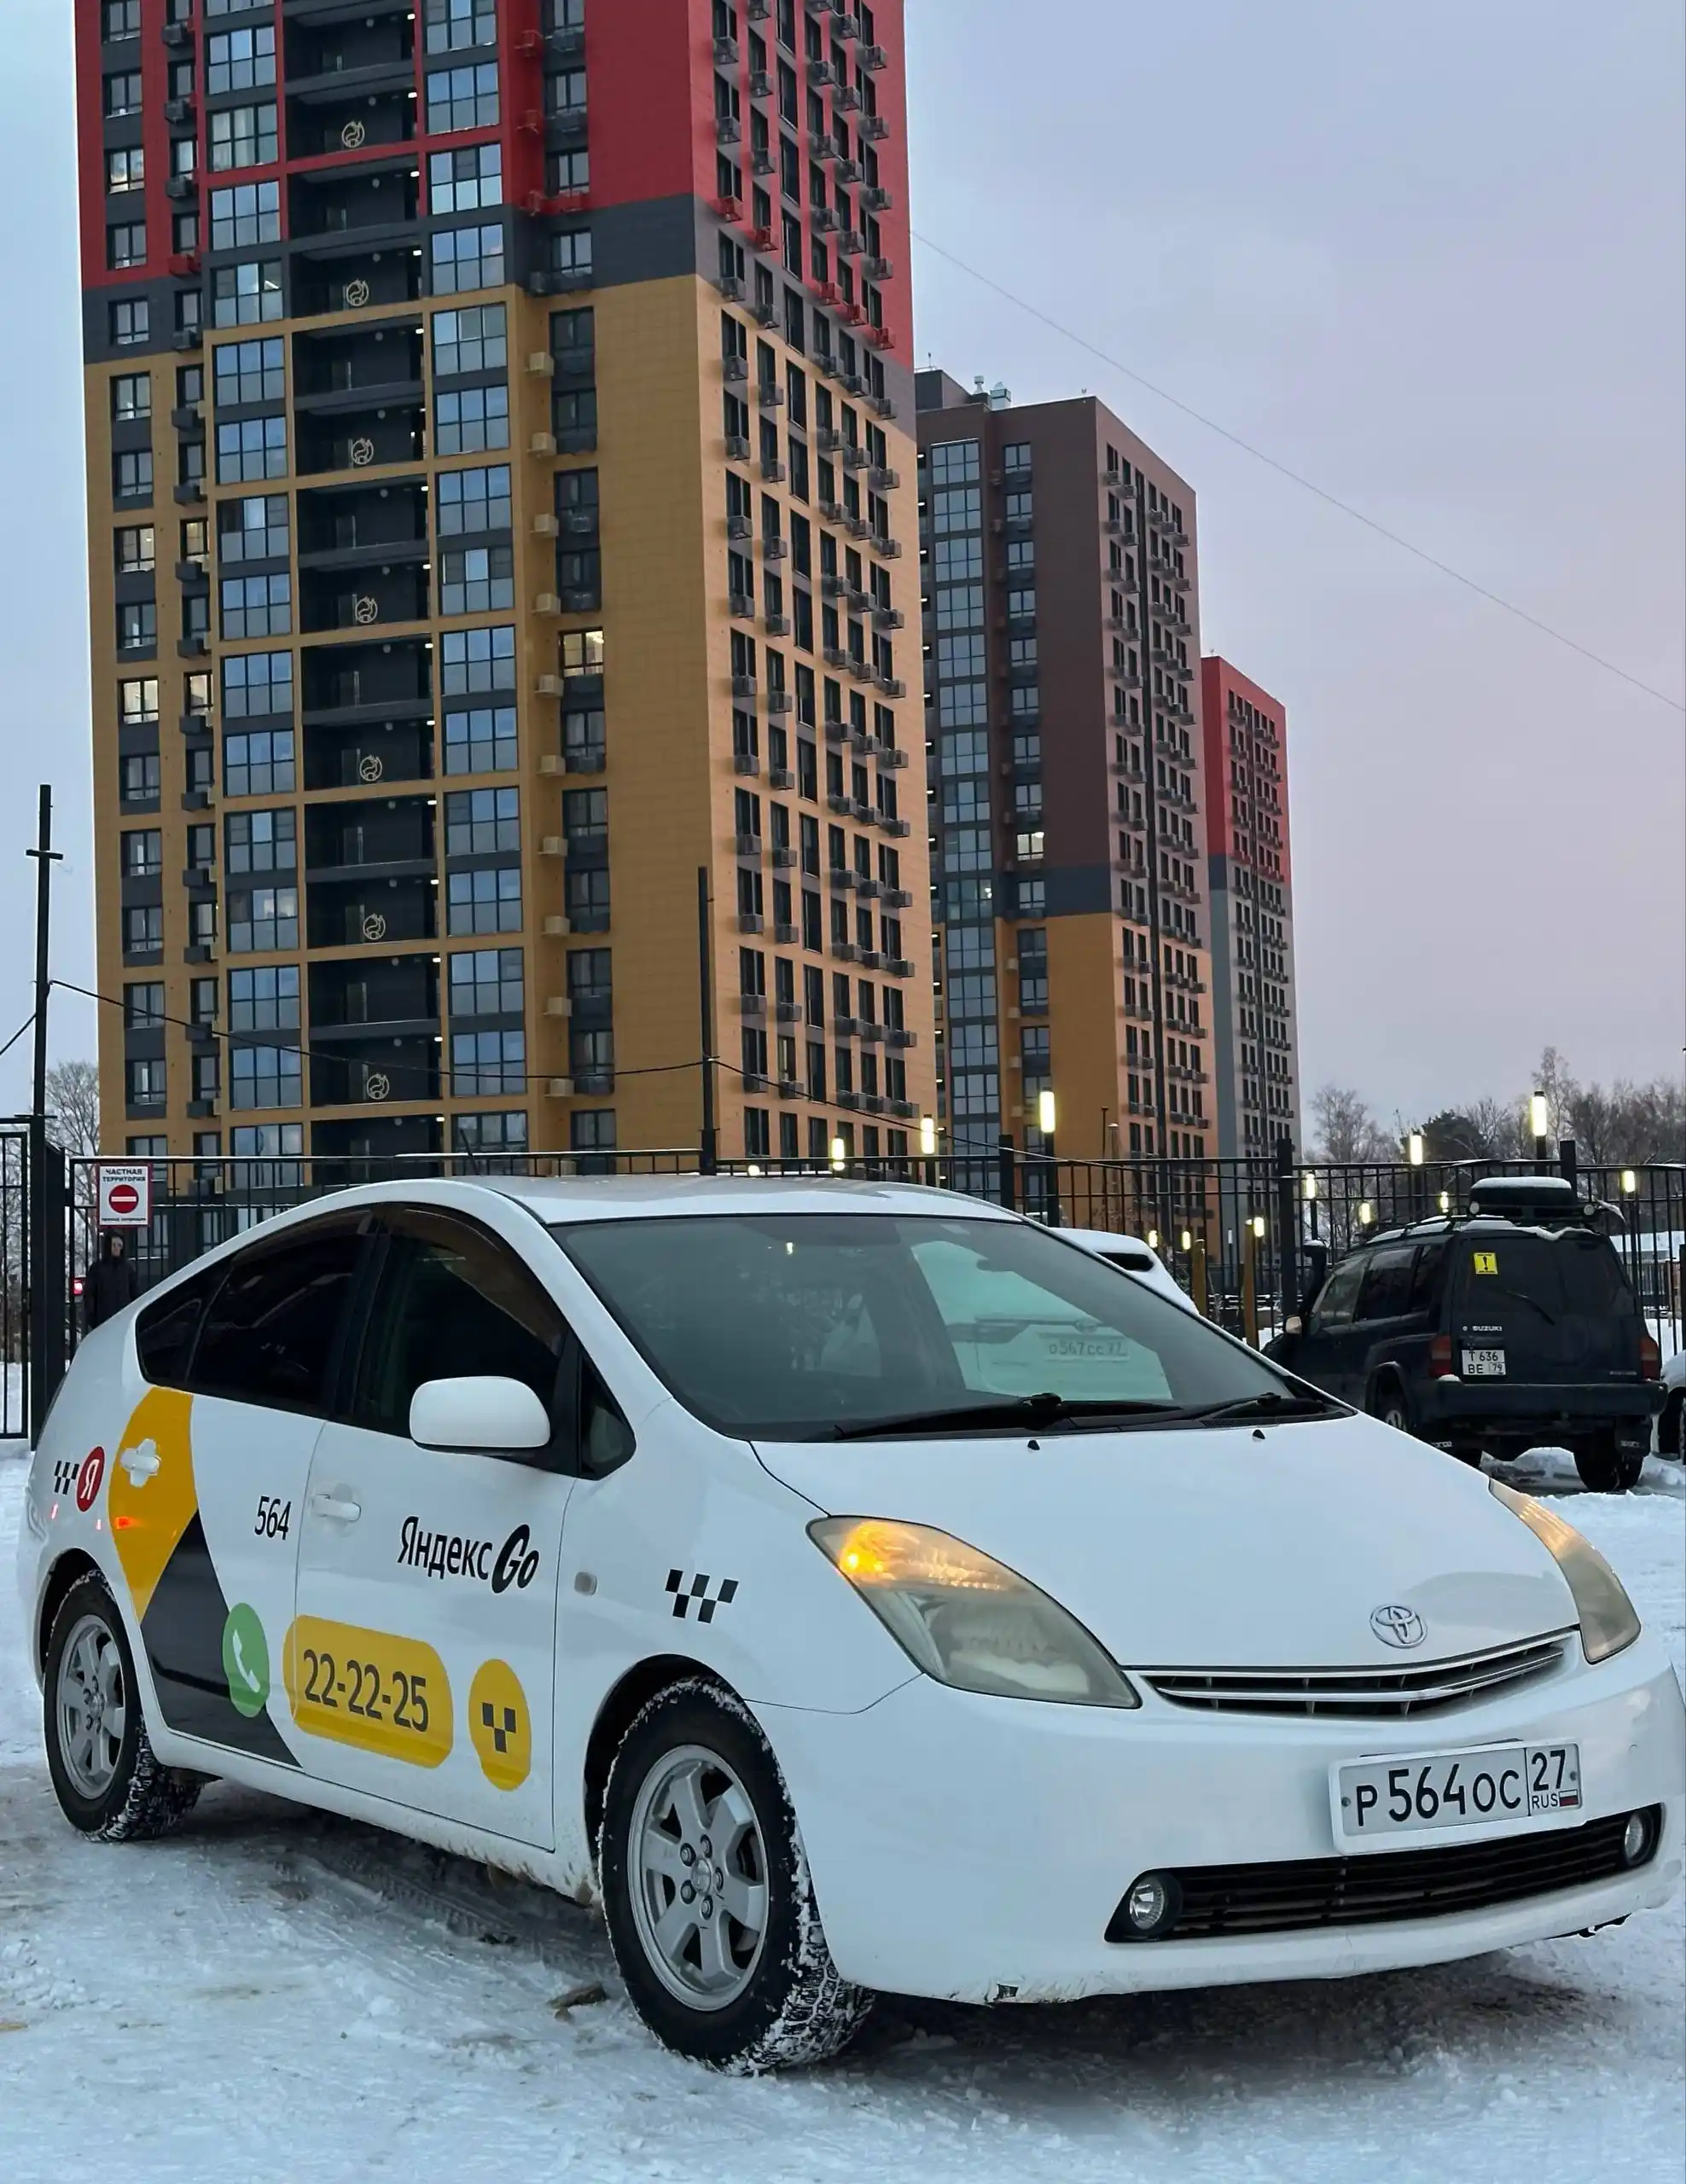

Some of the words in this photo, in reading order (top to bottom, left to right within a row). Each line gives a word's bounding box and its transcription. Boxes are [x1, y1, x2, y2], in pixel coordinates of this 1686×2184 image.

[255, 1495, 291, 1541] 564
[397, 1515, 493, 1580] Яндекс
[491, 1524, 539, 1594] Go
[303, 1649, 427, 1732] 22-22-25
[1531, 1750, 1567, 1792] 27
[1532, 1792, 1558, 1809] RUS
